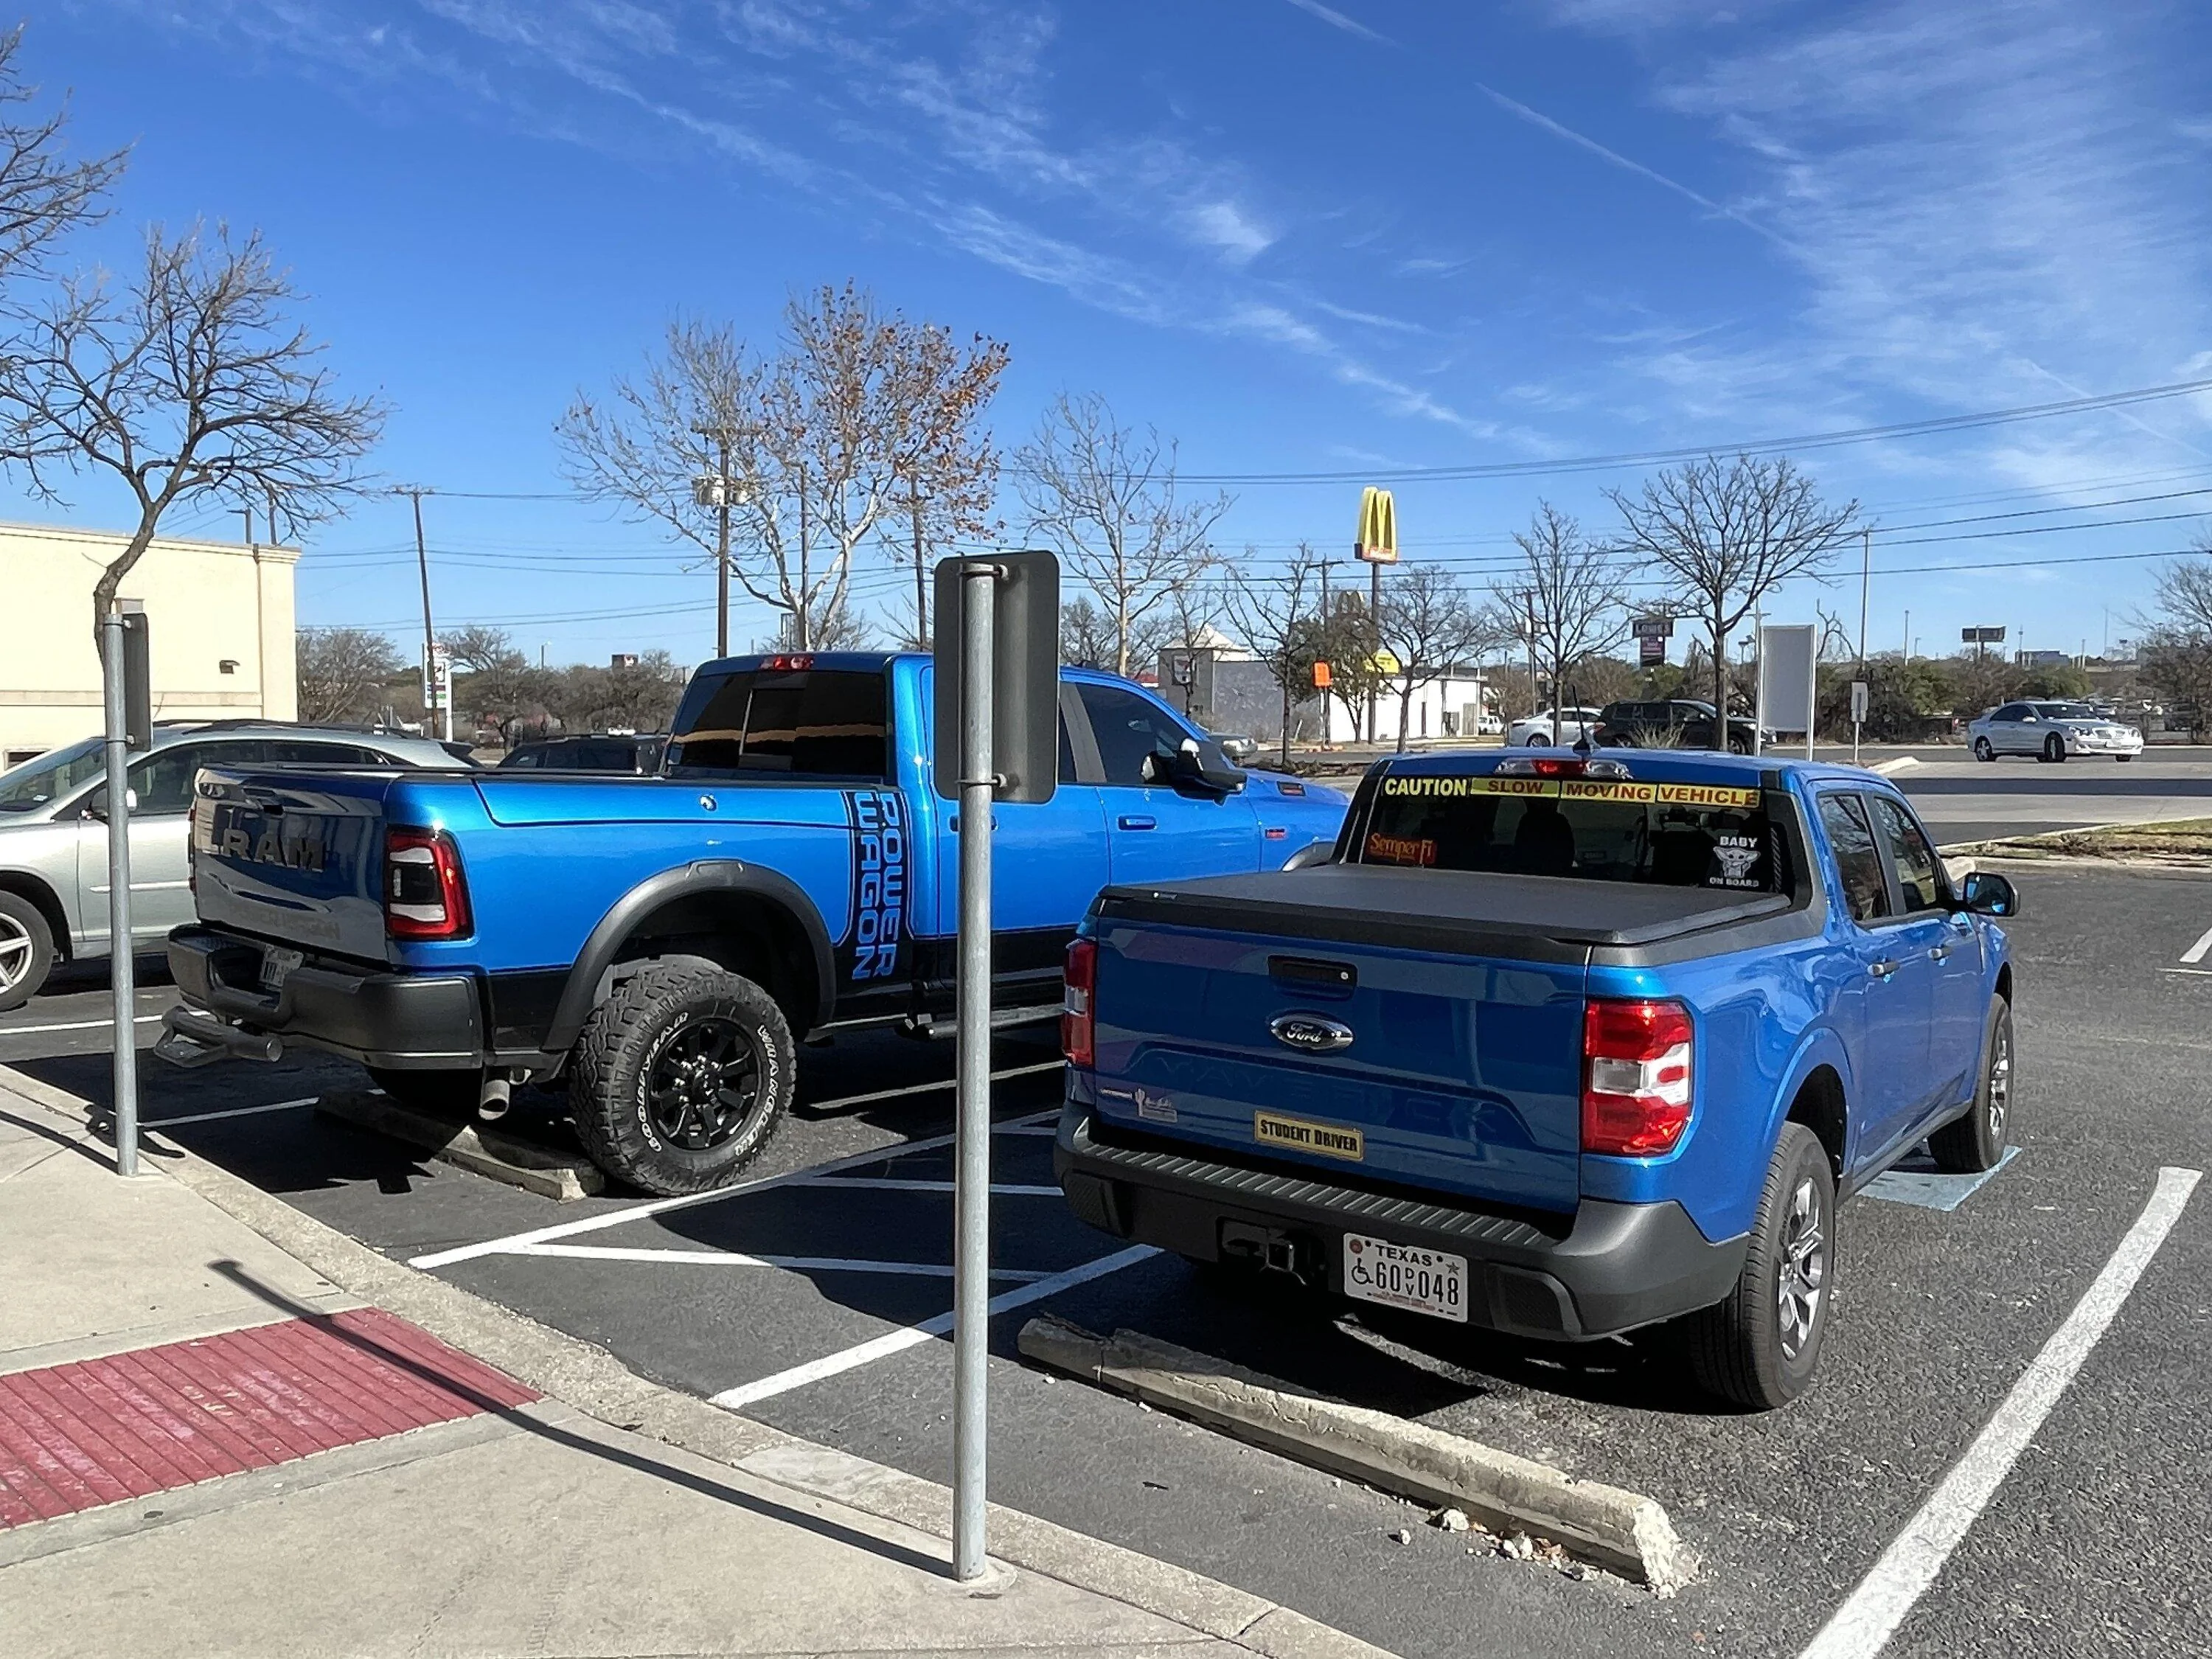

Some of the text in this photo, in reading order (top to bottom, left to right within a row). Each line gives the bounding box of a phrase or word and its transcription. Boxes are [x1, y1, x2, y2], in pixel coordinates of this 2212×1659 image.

[1385, 778, 1759, 805] CAUTION SLOW MOVING VEHICLE
[223, 827, 325, 873] RAM
[1719, 835, 1758, 848] BABY
[852, 792, 881, 980] WAGON
[873, 792, 903, 976] POWER
[1709, 877, 1759, 888] ON BOARD
[1286, 1023, 1324, 1043] Ford
[1260, 1119, 1357, 1152] STUDENT DRIVER
[1375, 1244, 1433, 1267] TEXAS
